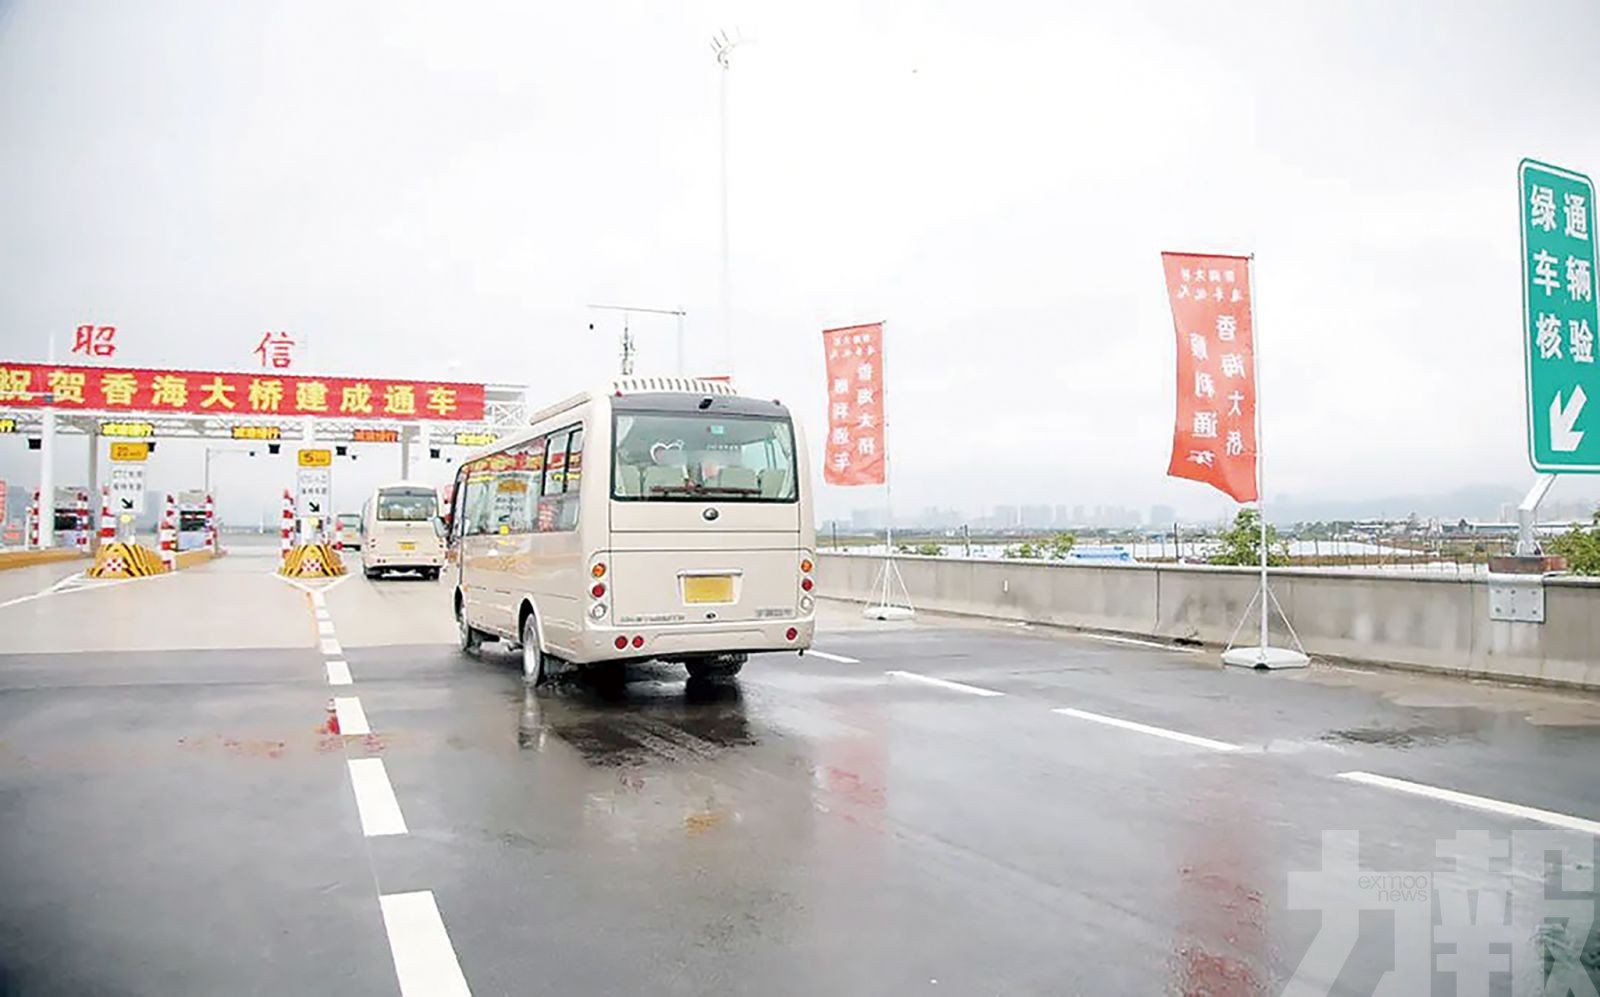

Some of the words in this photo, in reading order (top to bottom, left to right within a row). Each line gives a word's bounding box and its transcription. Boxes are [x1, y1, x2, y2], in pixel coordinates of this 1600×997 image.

[1531, 184, 1588, 241] 绿通
[1533, 249, 1592, 302] 车辆
[1536, 312, 1594, 364] 核验
[0, 367, 458, 415] 祝贺香海大桥建成通车
